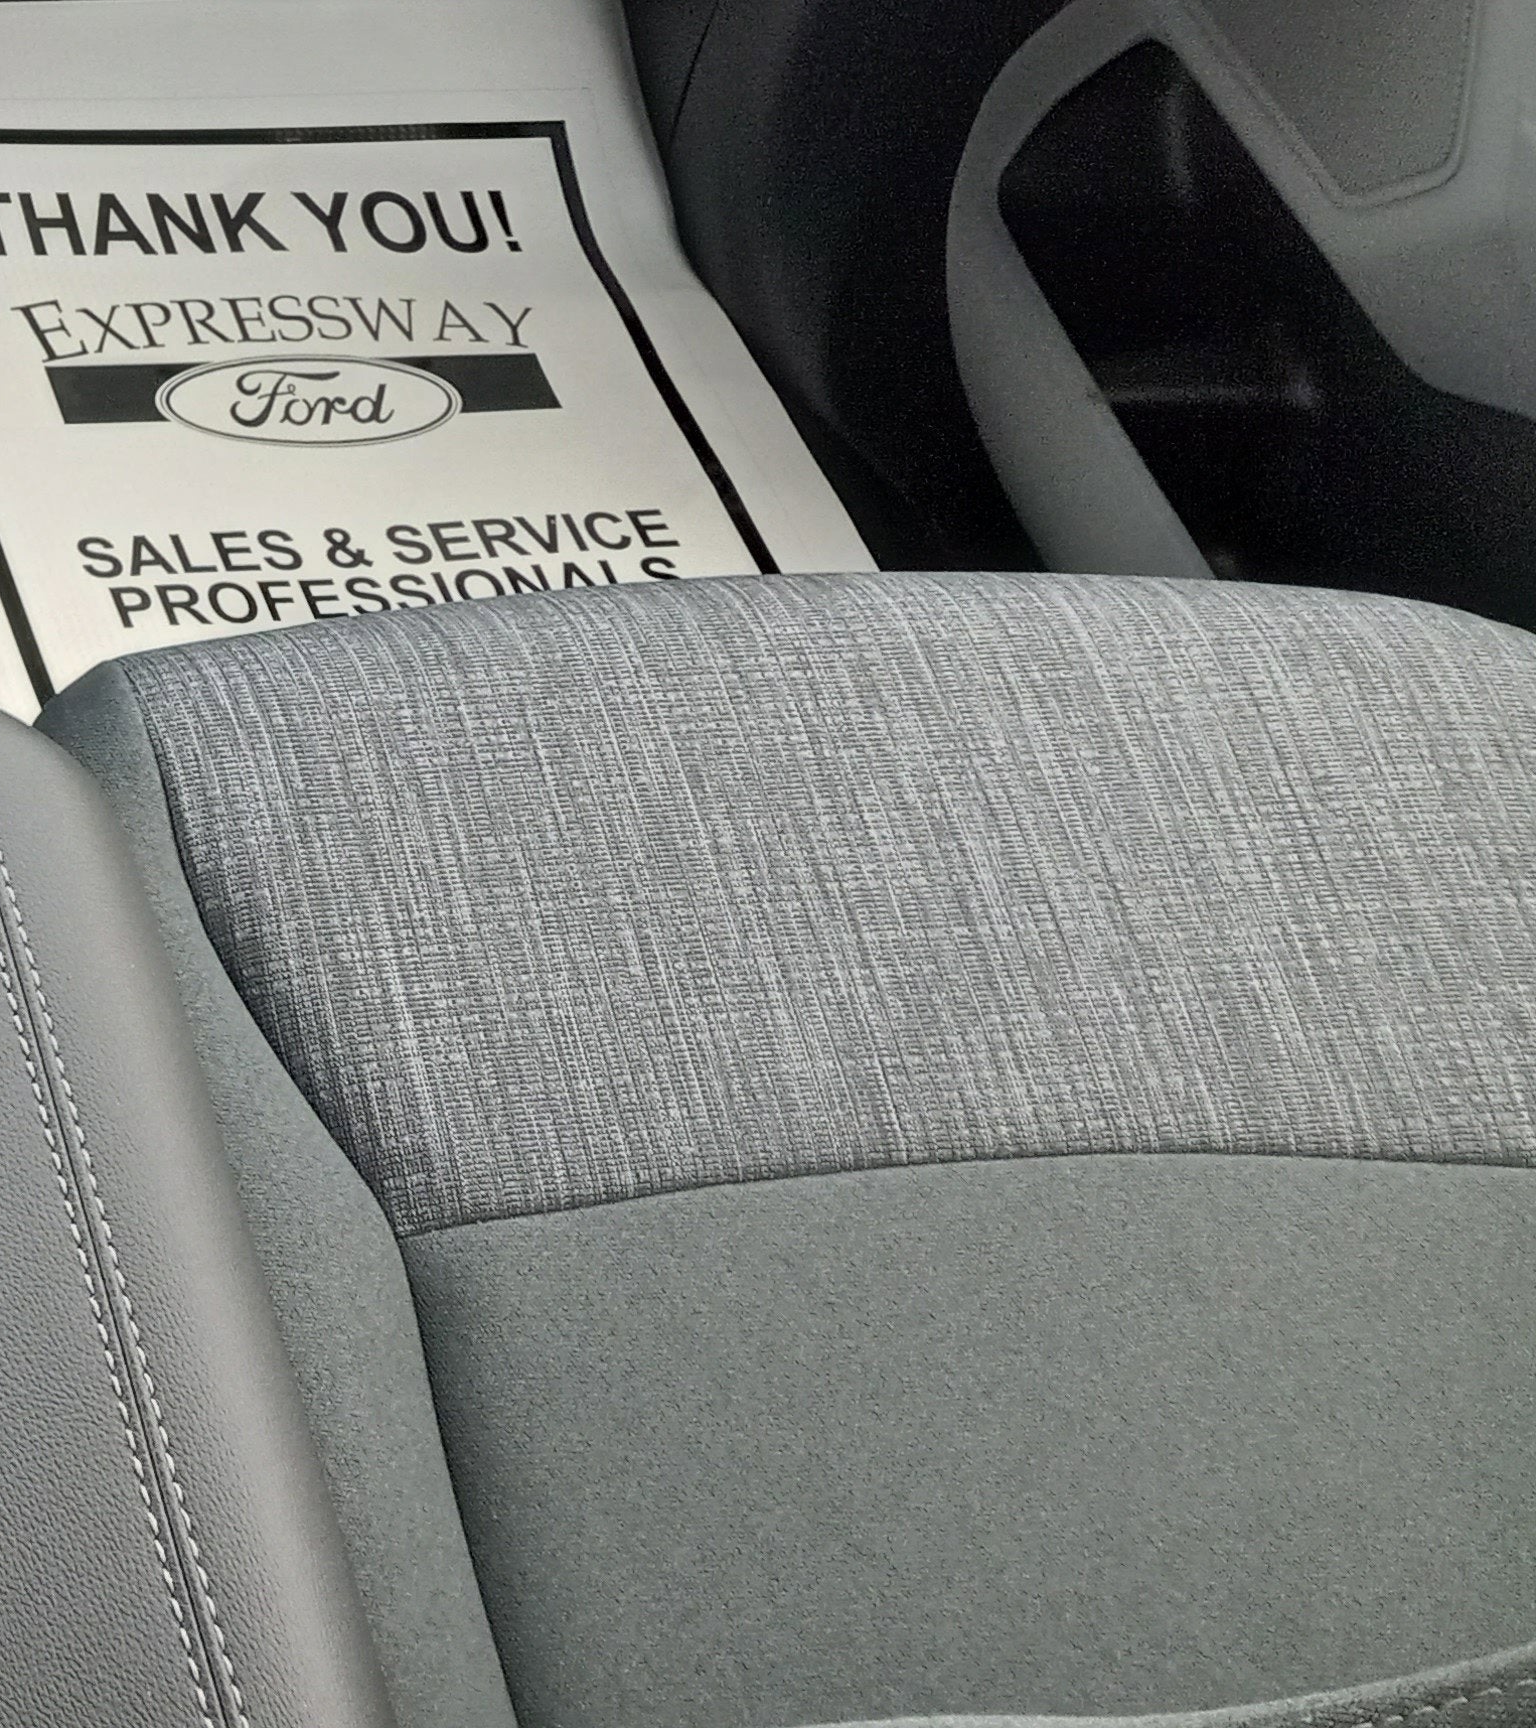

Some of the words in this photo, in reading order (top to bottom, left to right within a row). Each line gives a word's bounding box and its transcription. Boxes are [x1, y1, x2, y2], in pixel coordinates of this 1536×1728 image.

[291, 189, 522, 254] YOU!
[10, 294, 533, 363] EXPRESSWAY
[228, 368, 396, 428] Ford
[77, 528, 304, 580] SALES
[325, 529, 370, 567] &
[385, 508, 680, 567] SERVICE
